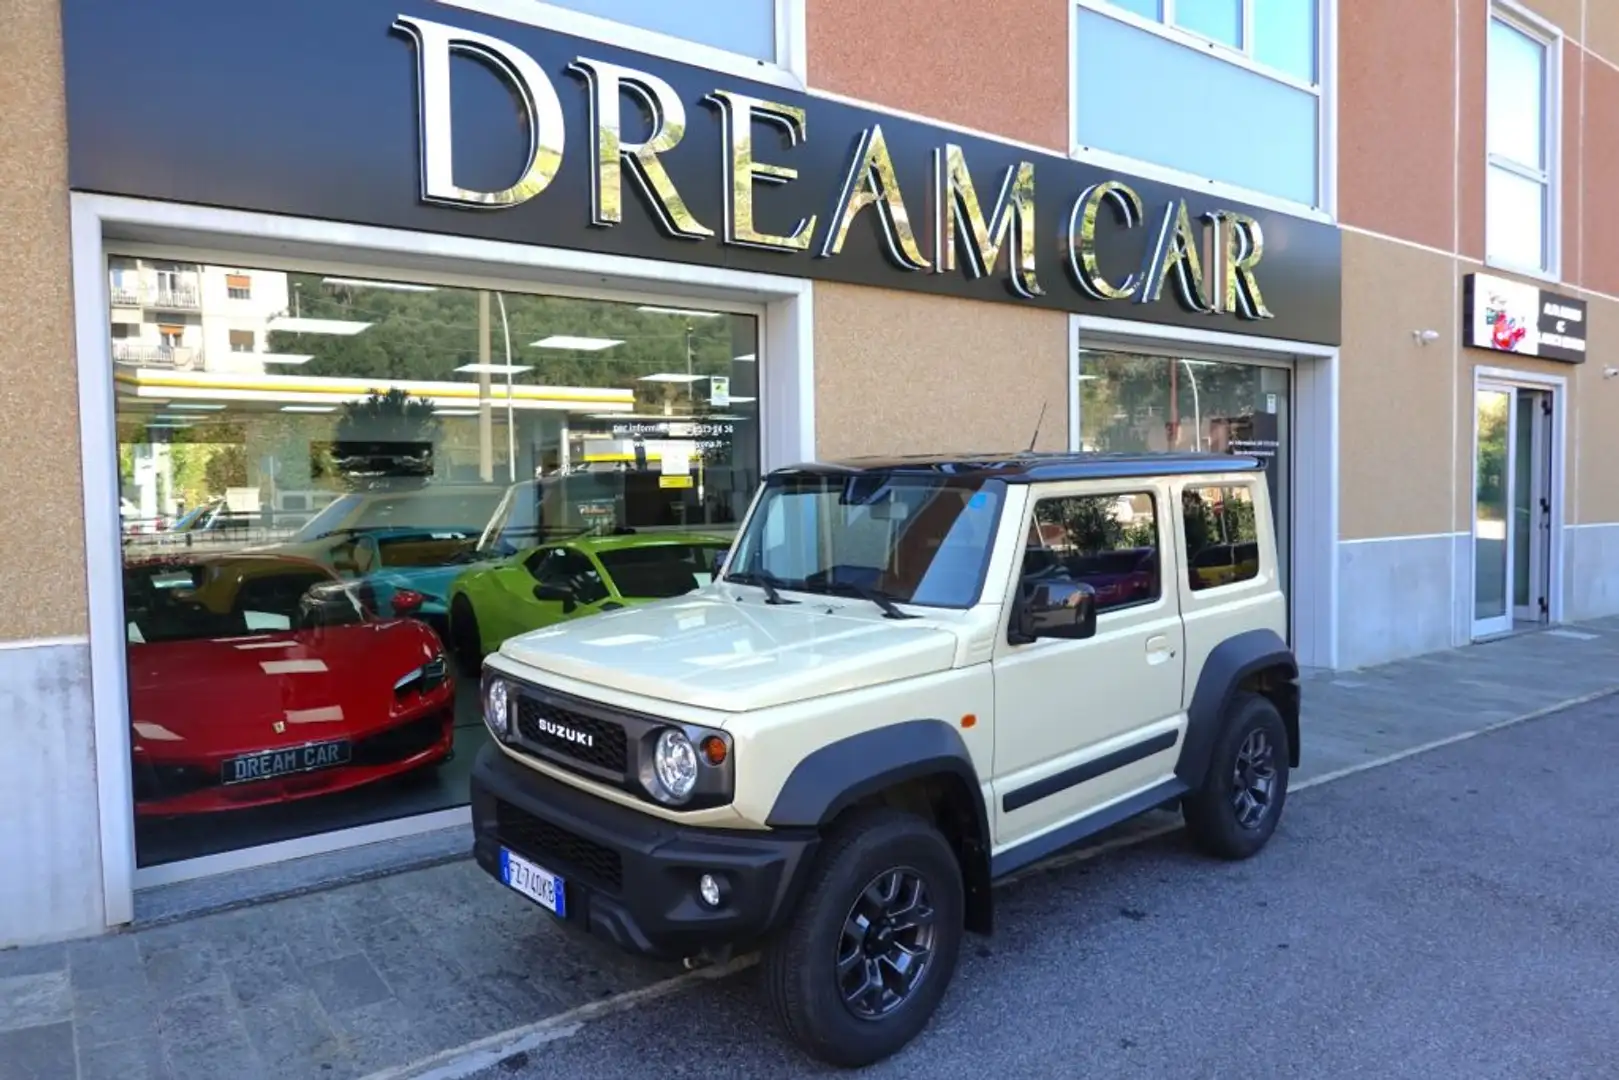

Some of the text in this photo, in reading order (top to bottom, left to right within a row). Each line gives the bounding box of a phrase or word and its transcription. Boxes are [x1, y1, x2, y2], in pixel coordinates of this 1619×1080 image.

[392, 14, 1275, 319] DREAM CAR
[539, 718, 593, 747] SUZUKI
[234, 743, 340, 780] DREAM CAR
